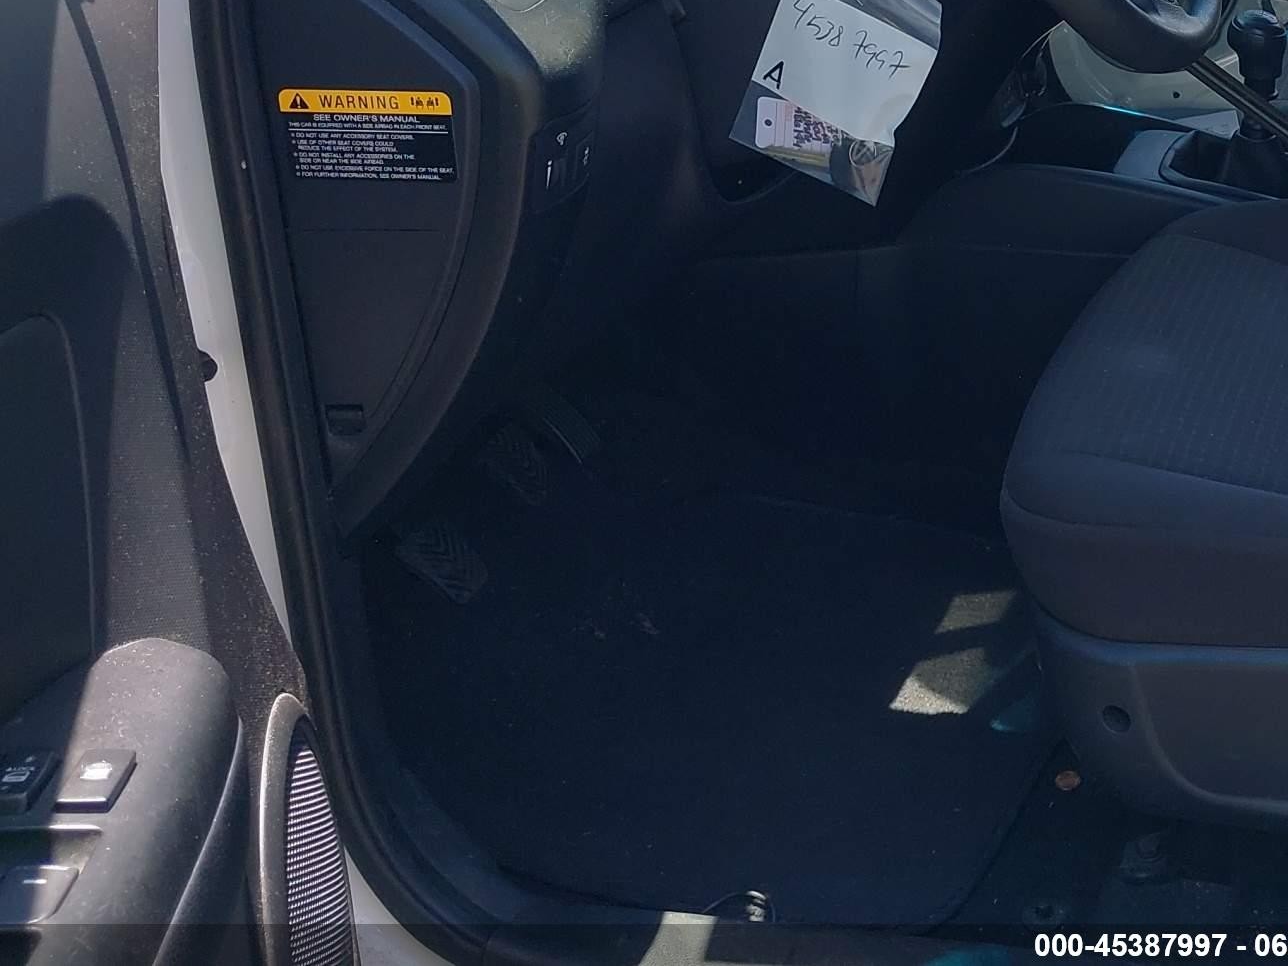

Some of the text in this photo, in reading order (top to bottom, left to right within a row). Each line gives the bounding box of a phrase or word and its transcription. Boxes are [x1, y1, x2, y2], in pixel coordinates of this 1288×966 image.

[762, 60, 785, 90] A
[318, 94, 400, 110] WARNING
[313, 114, 421, 123] SEE OWNER'S MANUAL
